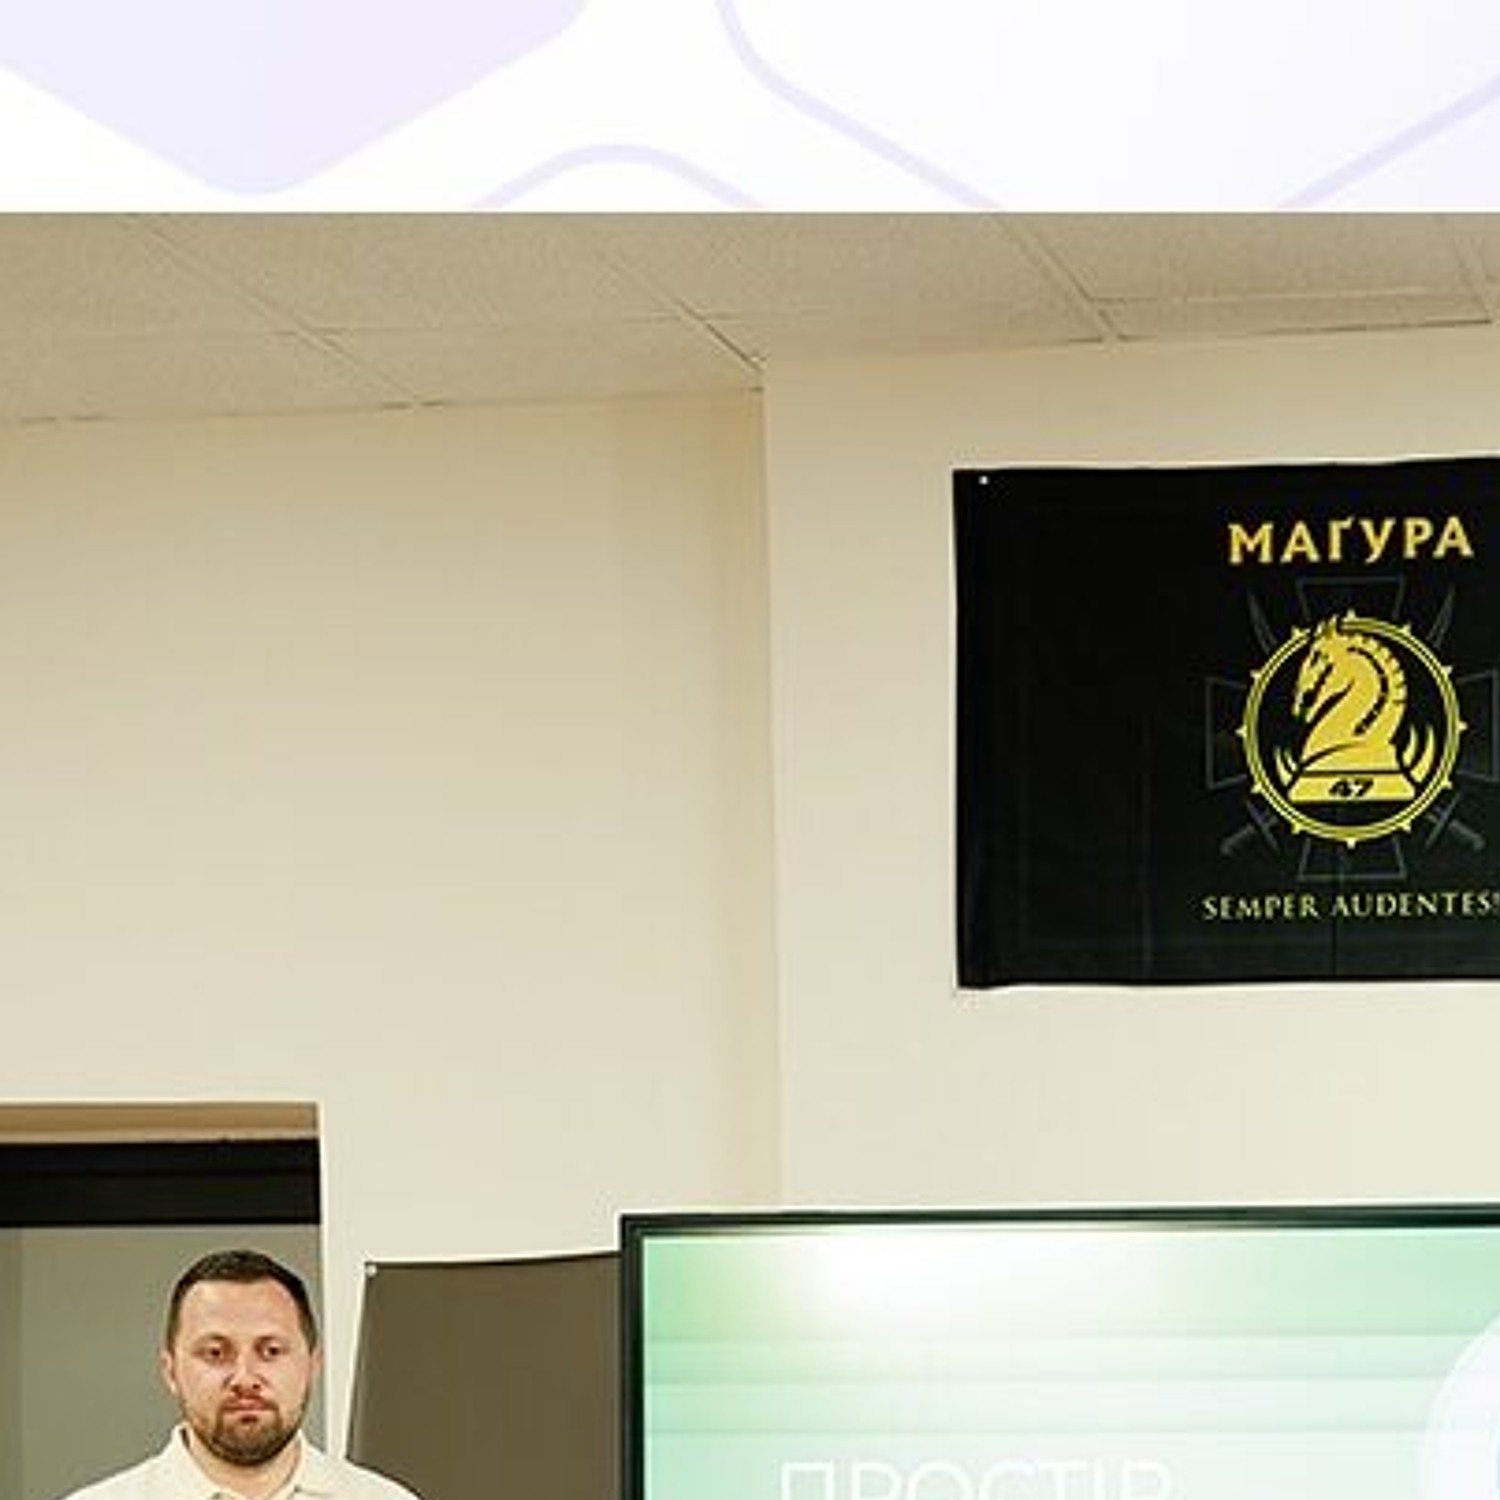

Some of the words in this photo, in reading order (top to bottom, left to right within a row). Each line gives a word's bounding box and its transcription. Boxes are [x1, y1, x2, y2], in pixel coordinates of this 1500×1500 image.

[1228, 516, 1474, 564] МАҐУРА
[1329, 778, 1374, 797] 47
[1203, 894, 1320, 921] SEMPER
